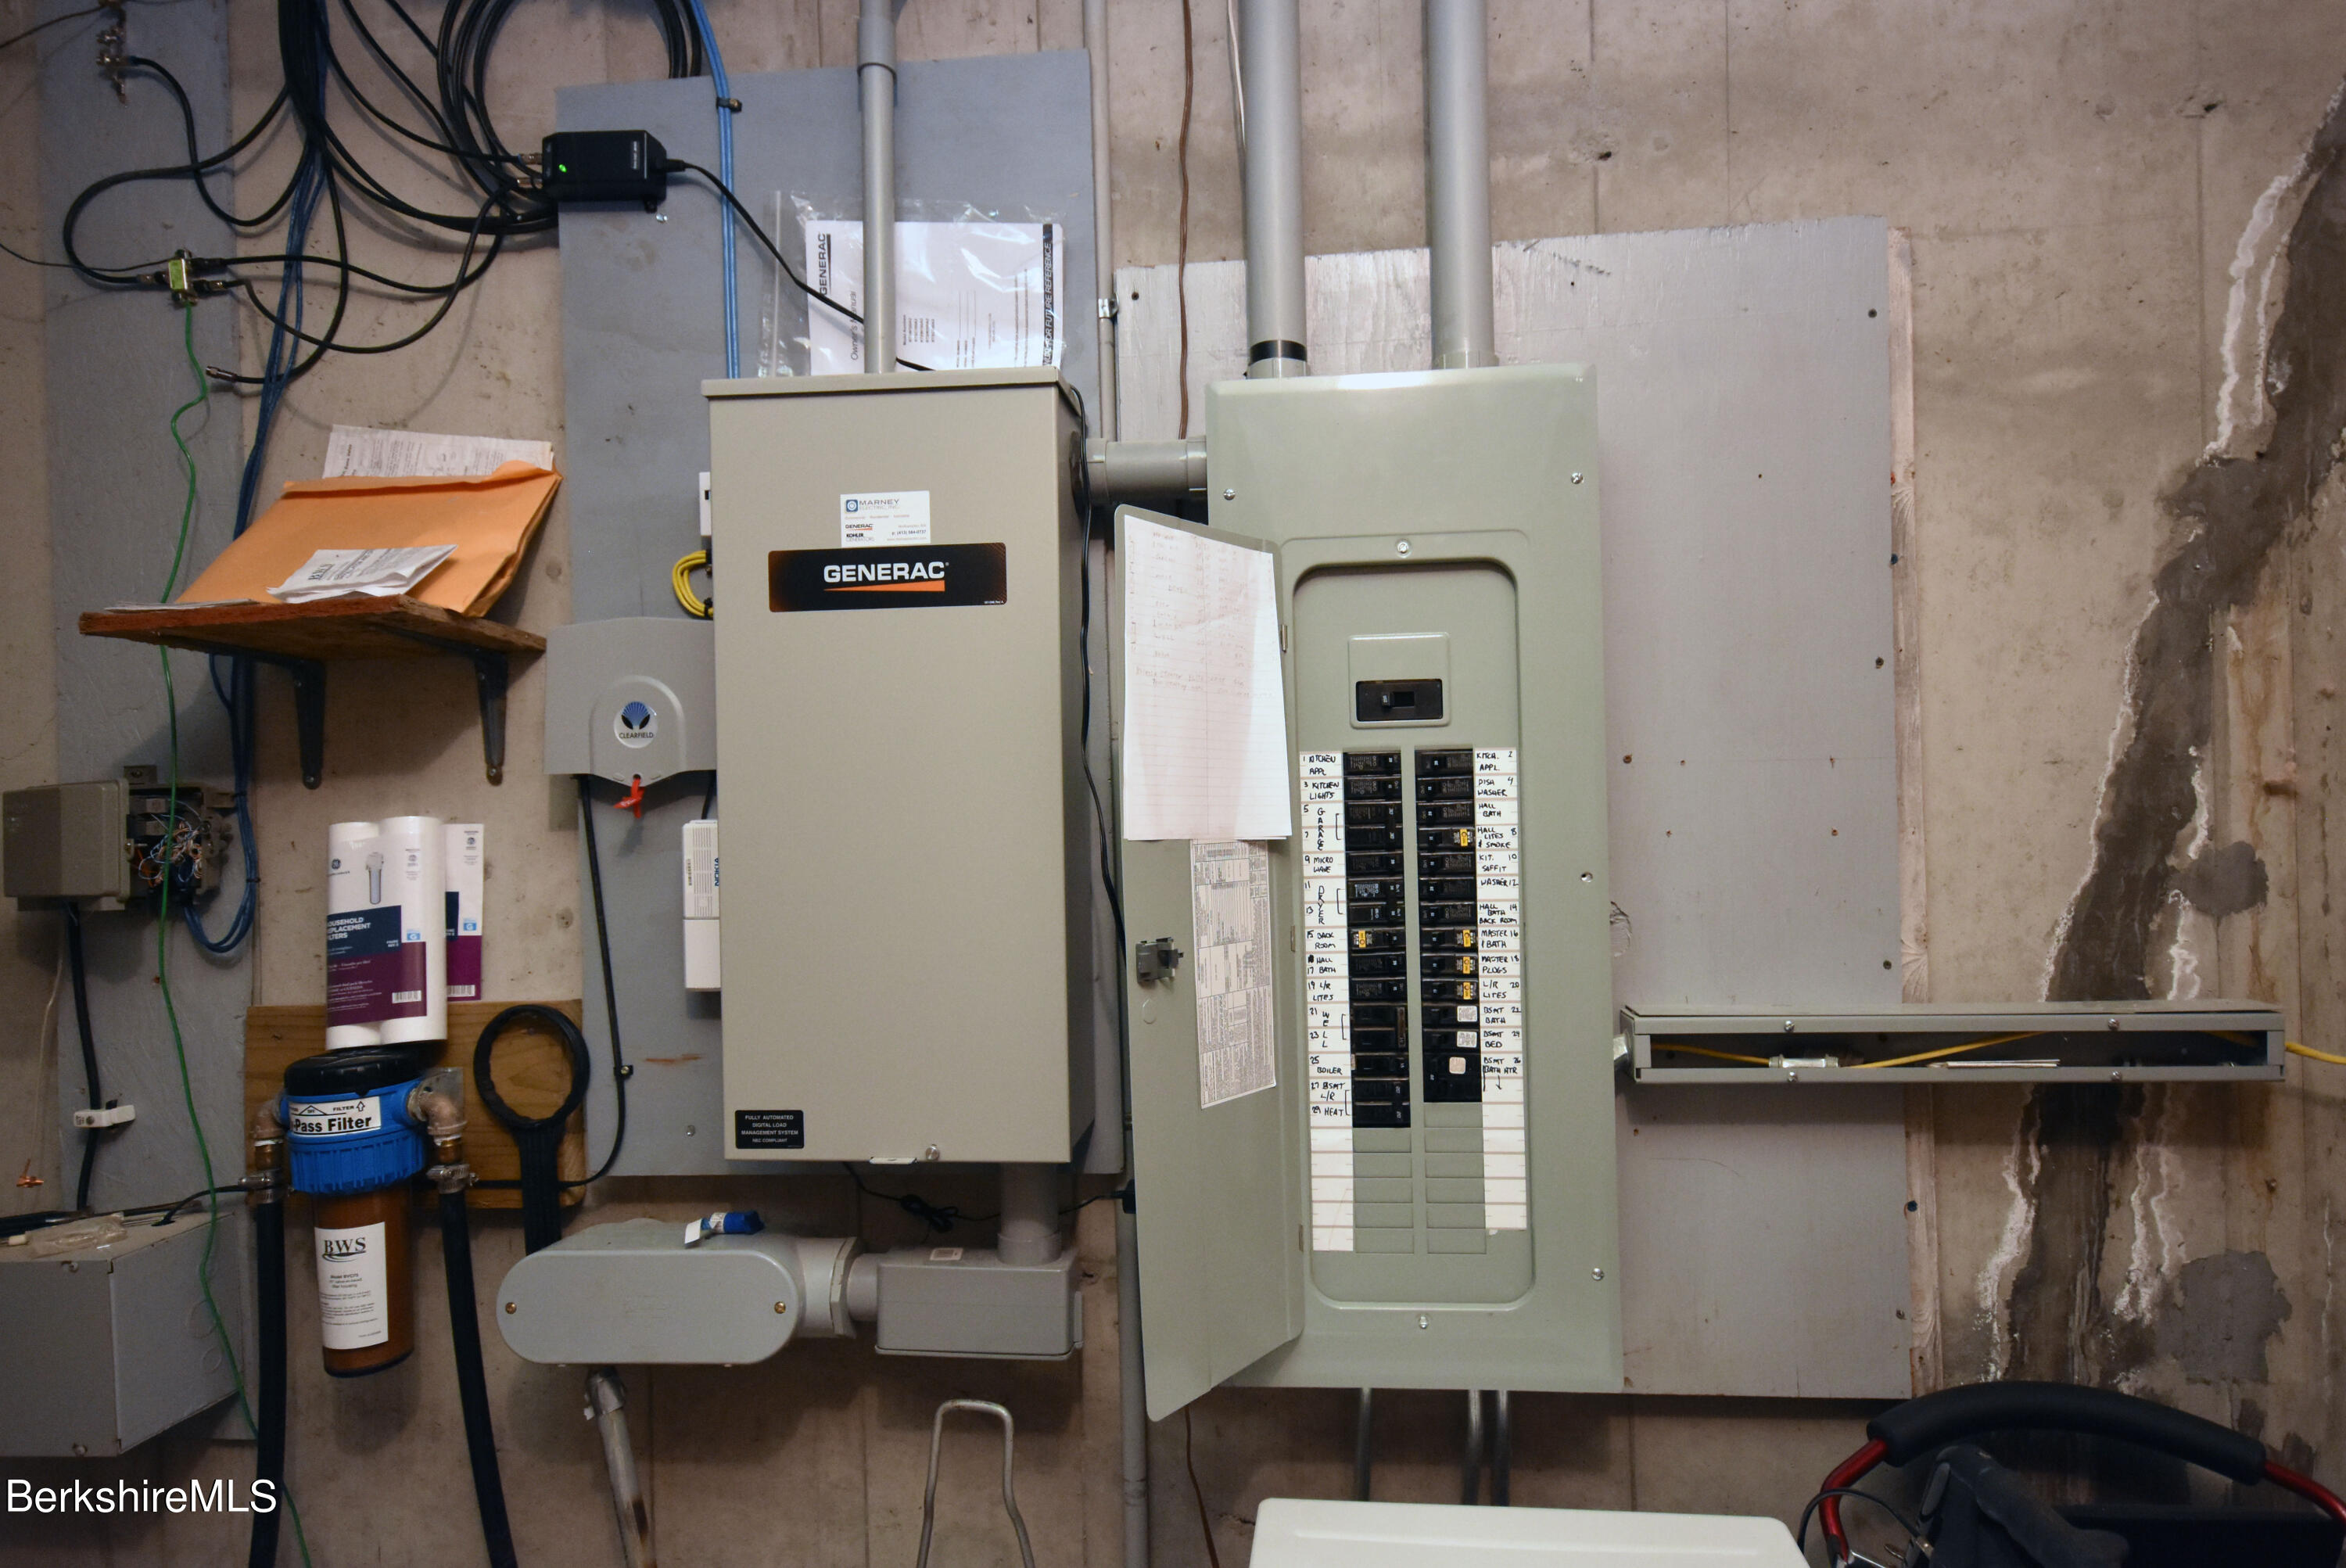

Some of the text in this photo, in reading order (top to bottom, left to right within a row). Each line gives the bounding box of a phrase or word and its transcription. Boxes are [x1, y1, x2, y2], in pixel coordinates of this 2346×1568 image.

[817, 233, 827, 296] GENERAC
[1043, 243, 1053, 294] REFERENCE
[1044, 295, 1053, 328] FUTURE
[823, 562, 945, 583] GENERAC
[1508, 777, 1514, 785] 4
[328, 917, 364, 928] OUSEHOLD
[1307, 966, 1314, 974] 17
[1482, 966, 1508, 974] PLUGS
[1308, 980, 1331, 990] 19 L/R
[1483, 980, 1498, 989] L/R
[1309, 1031, 1319, 1039] 23
[1310, 1056, 1319, 1064] 25
[1317, 1067, 1343, 1075] BOILER
[1321, 1090, 1335, 1101] L/R
[1311, 1106, 1344, 1117] 29 HEAT
[328, 1117, 371, 1131] Filter
[324, 1237, 366, 1254] BWS
